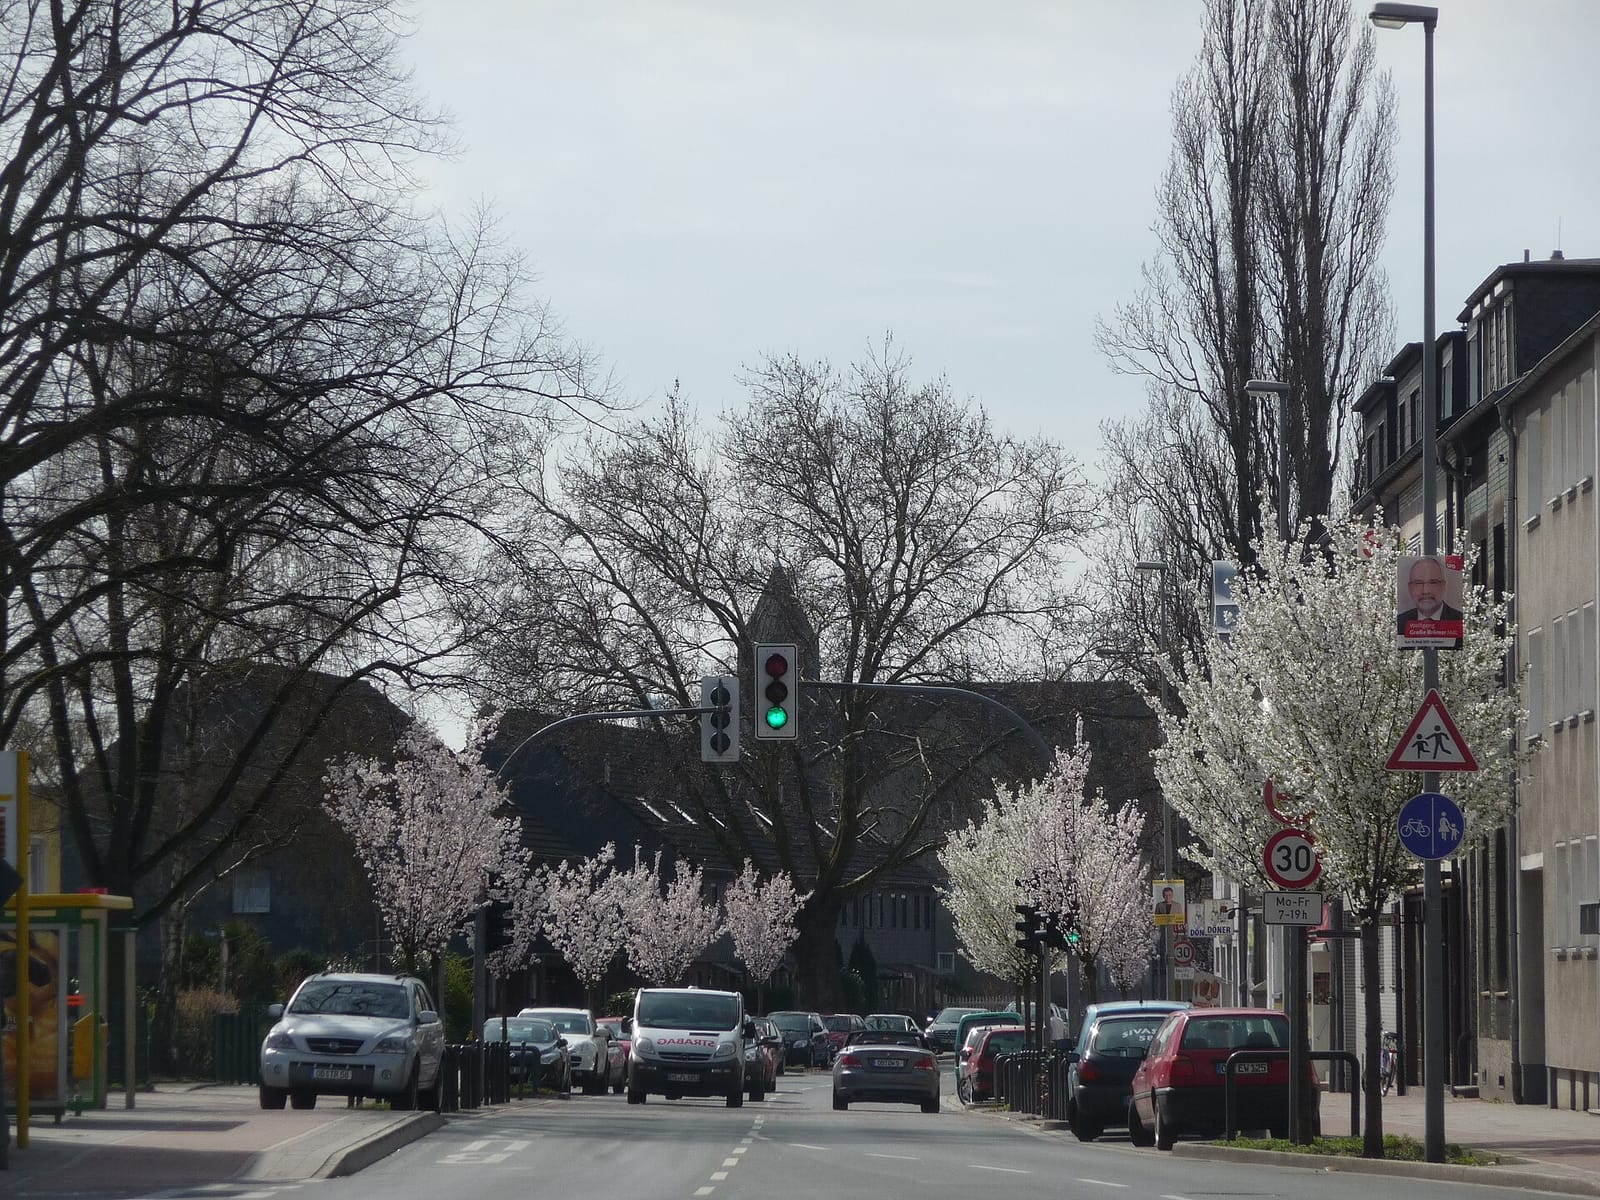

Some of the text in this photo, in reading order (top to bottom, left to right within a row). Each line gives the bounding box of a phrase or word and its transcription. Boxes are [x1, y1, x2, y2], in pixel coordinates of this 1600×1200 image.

[1276, 845, 1311, 872] 30
[1276, 896, 1310, 907] Mo-Fr
[1176, 946, 1191, 959] 30
